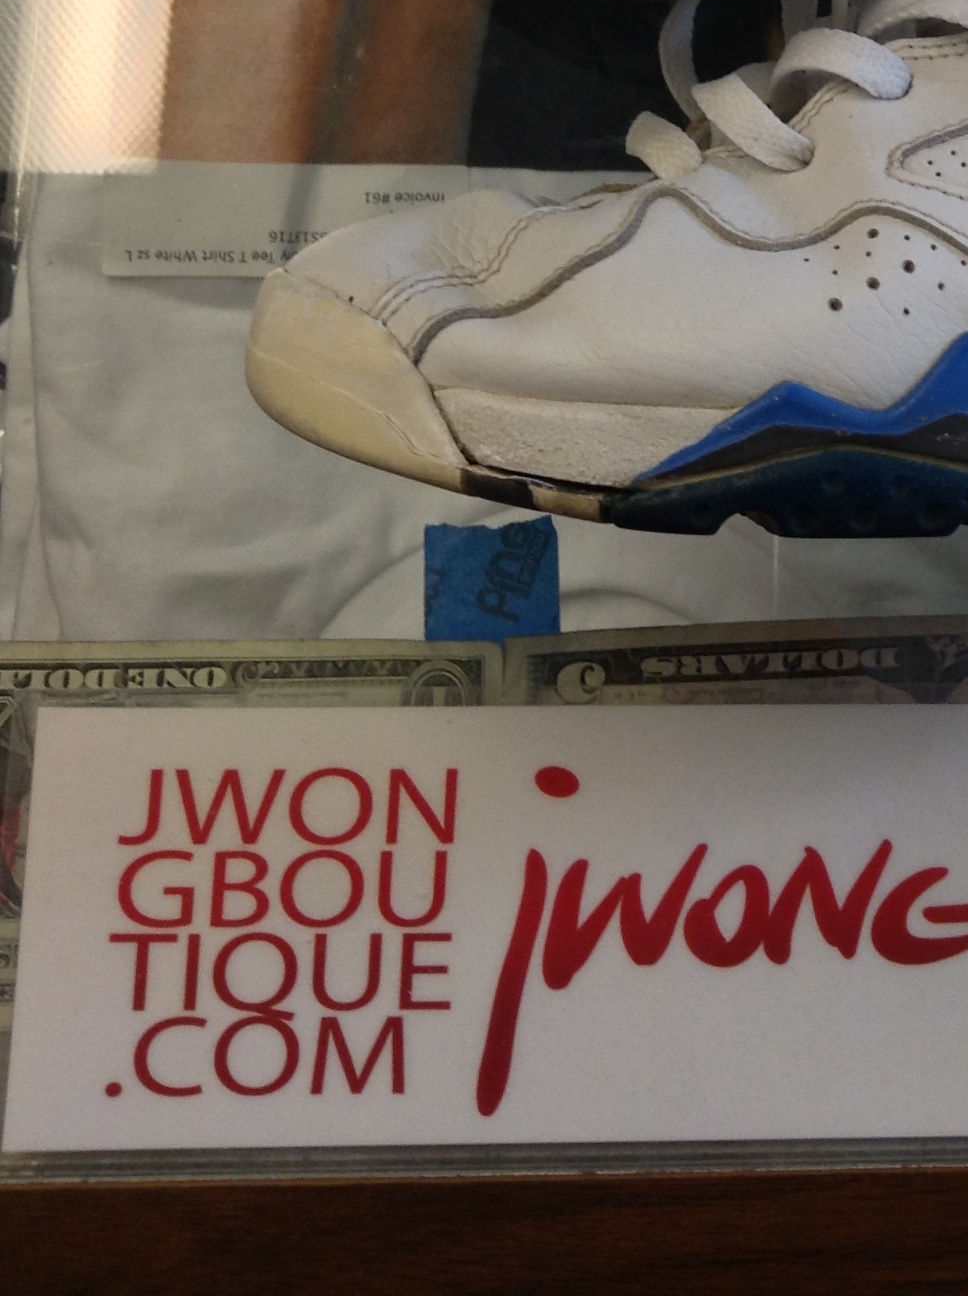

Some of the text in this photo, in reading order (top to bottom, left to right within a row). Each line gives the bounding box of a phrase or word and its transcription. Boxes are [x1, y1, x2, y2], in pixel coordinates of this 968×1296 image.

[155, 248, 199, 263] White
[202, 249, 235, 263] Shirt
[238, 249, 248, 263] T
[252, 249, 278, 263] Tee
[125, 667, 228, 689] ONE
[116, 766, 460, 848] JWON
[116, 848, 450, 931] GBOU
[108, 931, 453, 1024] TIQUE
[105, 1015, 405, 1097] .COM
